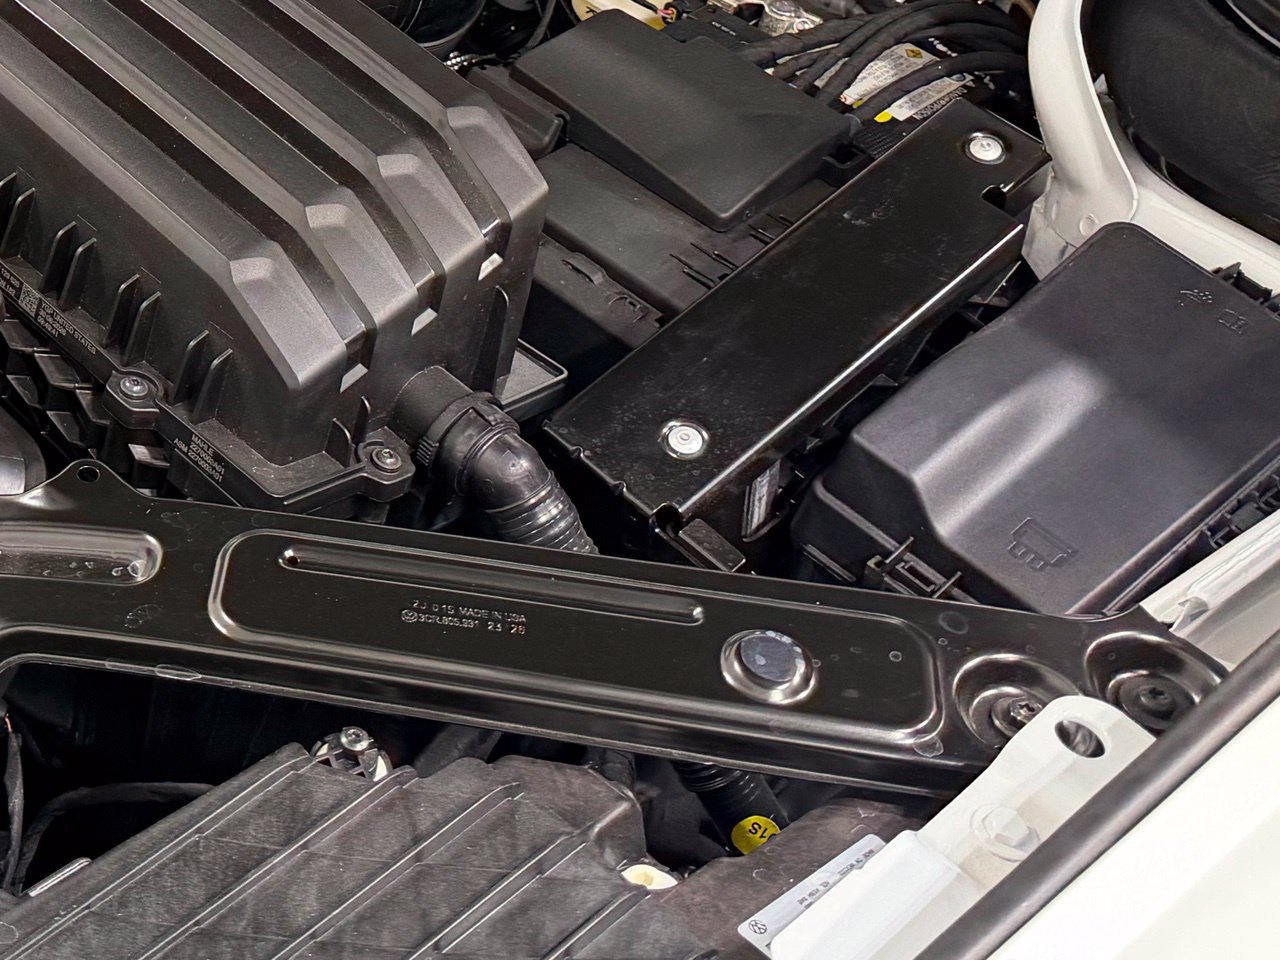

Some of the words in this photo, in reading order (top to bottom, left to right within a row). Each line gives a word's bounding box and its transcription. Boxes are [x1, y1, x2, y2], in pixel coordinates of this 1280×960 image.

[53, 312, 74, 333] UNITED
[73, 331, 96, 354] STATES
[192, 434, 214, 456] MAHLE
[459, 606, 489, 619] MADE
